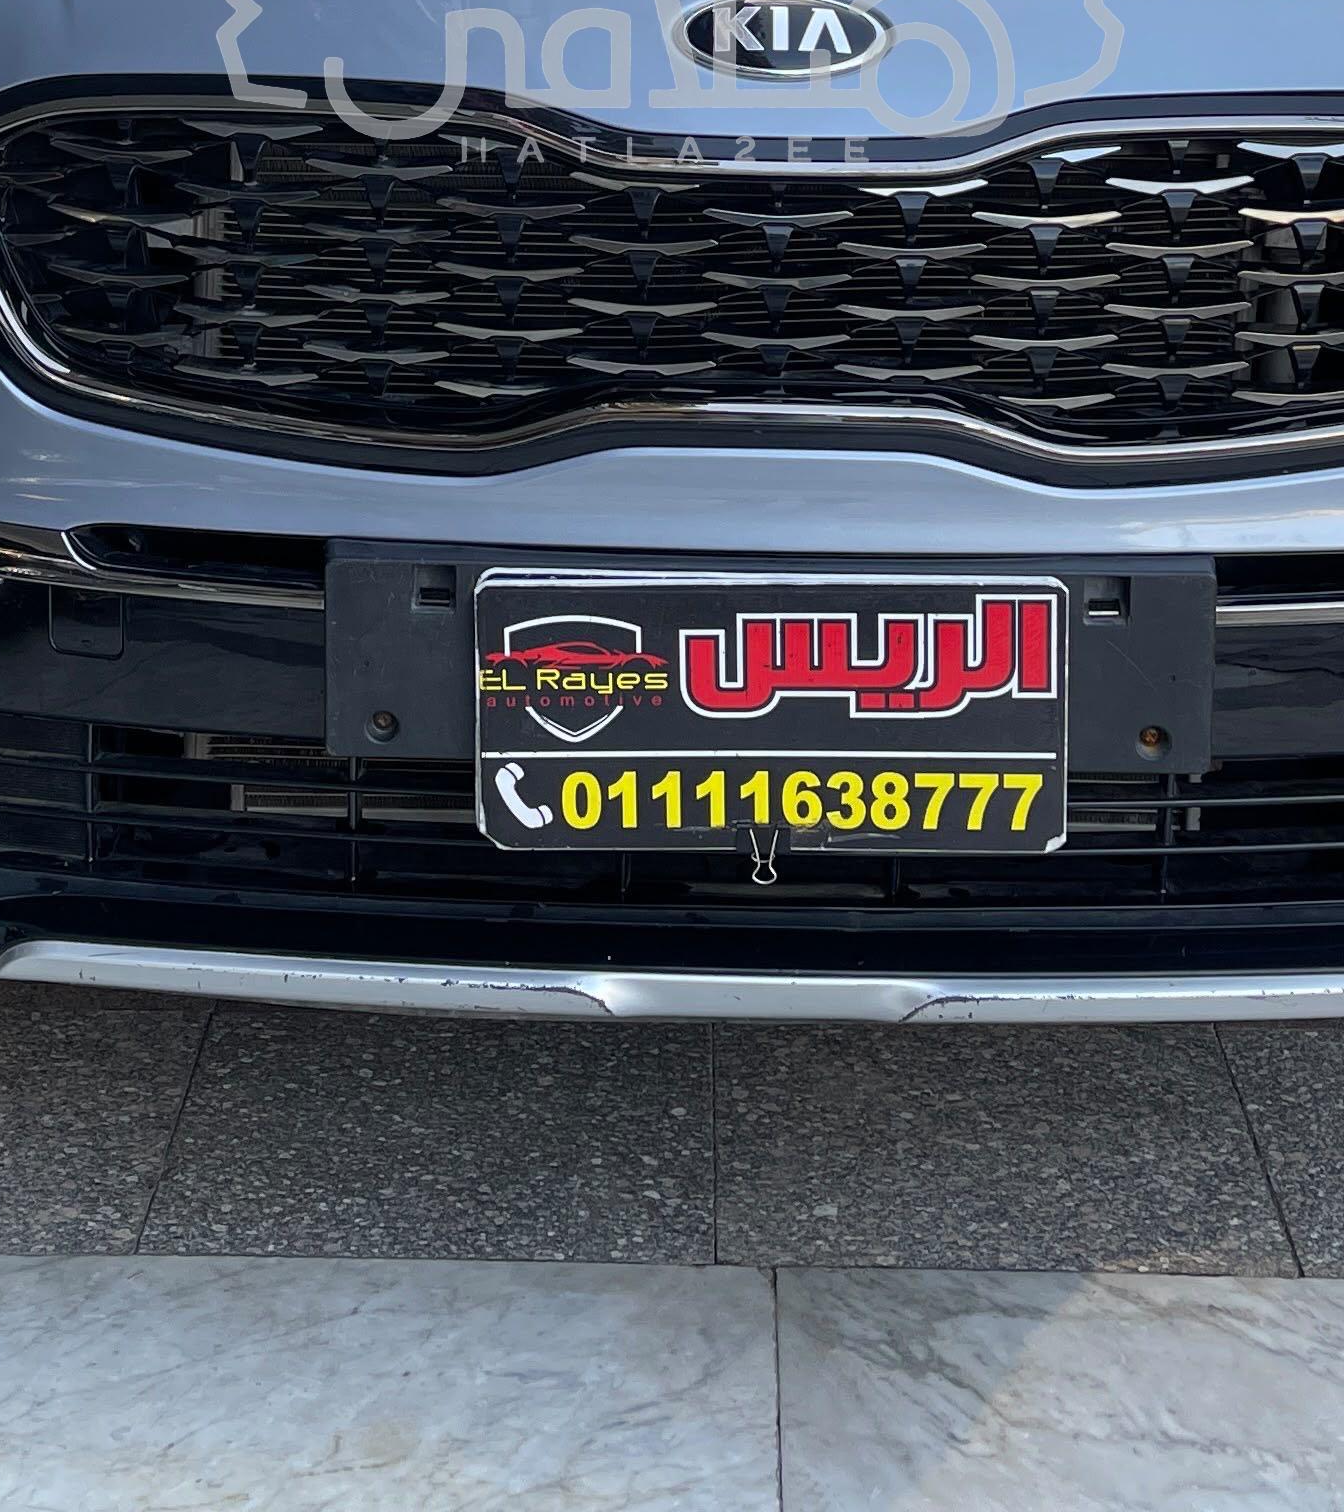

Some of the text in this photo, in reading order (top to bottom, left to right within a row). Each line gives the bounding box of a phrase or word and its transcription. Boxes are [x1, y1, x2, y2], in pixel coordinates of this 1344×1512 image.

[712, 4, 853, 55] KIA
[479, 668, 670, 695] EL Rayes
[680, 595, 1058, 719] الريس
[485, 694, 664, 708] automotive
[560, 770, 1044, 830] 01111638777
